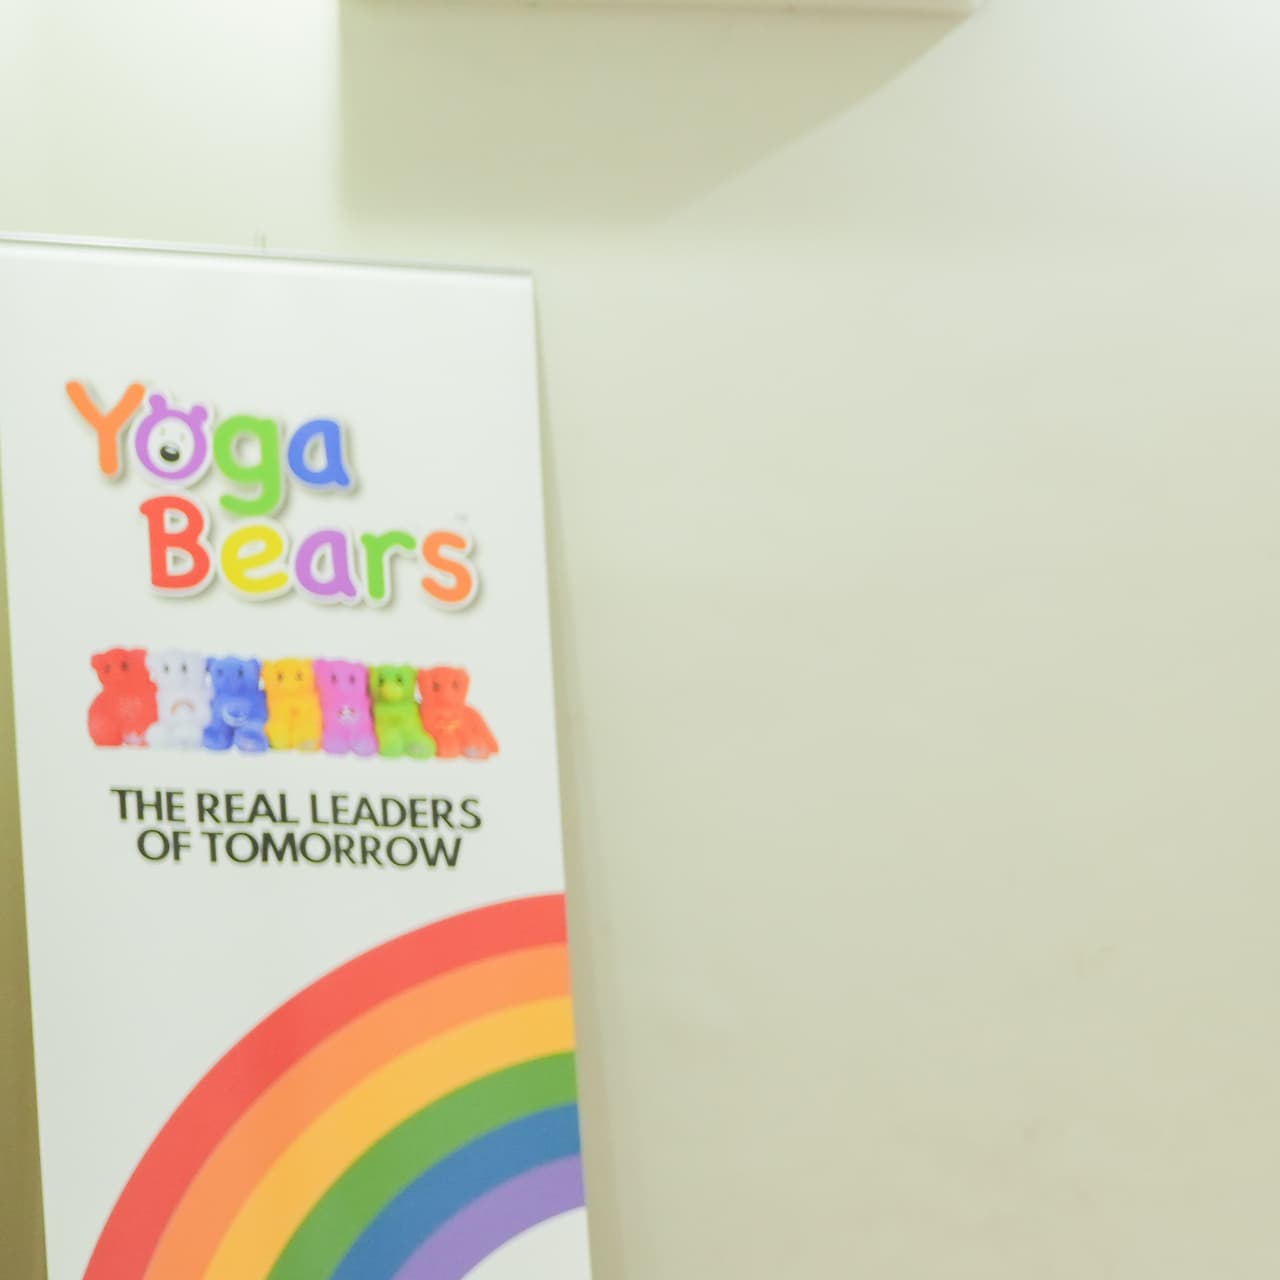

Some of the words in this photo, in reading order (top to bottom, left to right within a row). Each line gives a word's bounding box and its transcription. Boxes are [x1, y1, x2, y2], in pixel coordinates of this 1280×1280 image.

[65, 380, 351, 516] Yoga
[139, 495, 473, 603] Bears
[110, 788, 186, 822] THE
[197, 792, 300, 824] REAL
[310, 794, 482, 830] LEADERS
[137, 829, 192, 861] OF
[201, 831, 462, 868] TOMORROW
